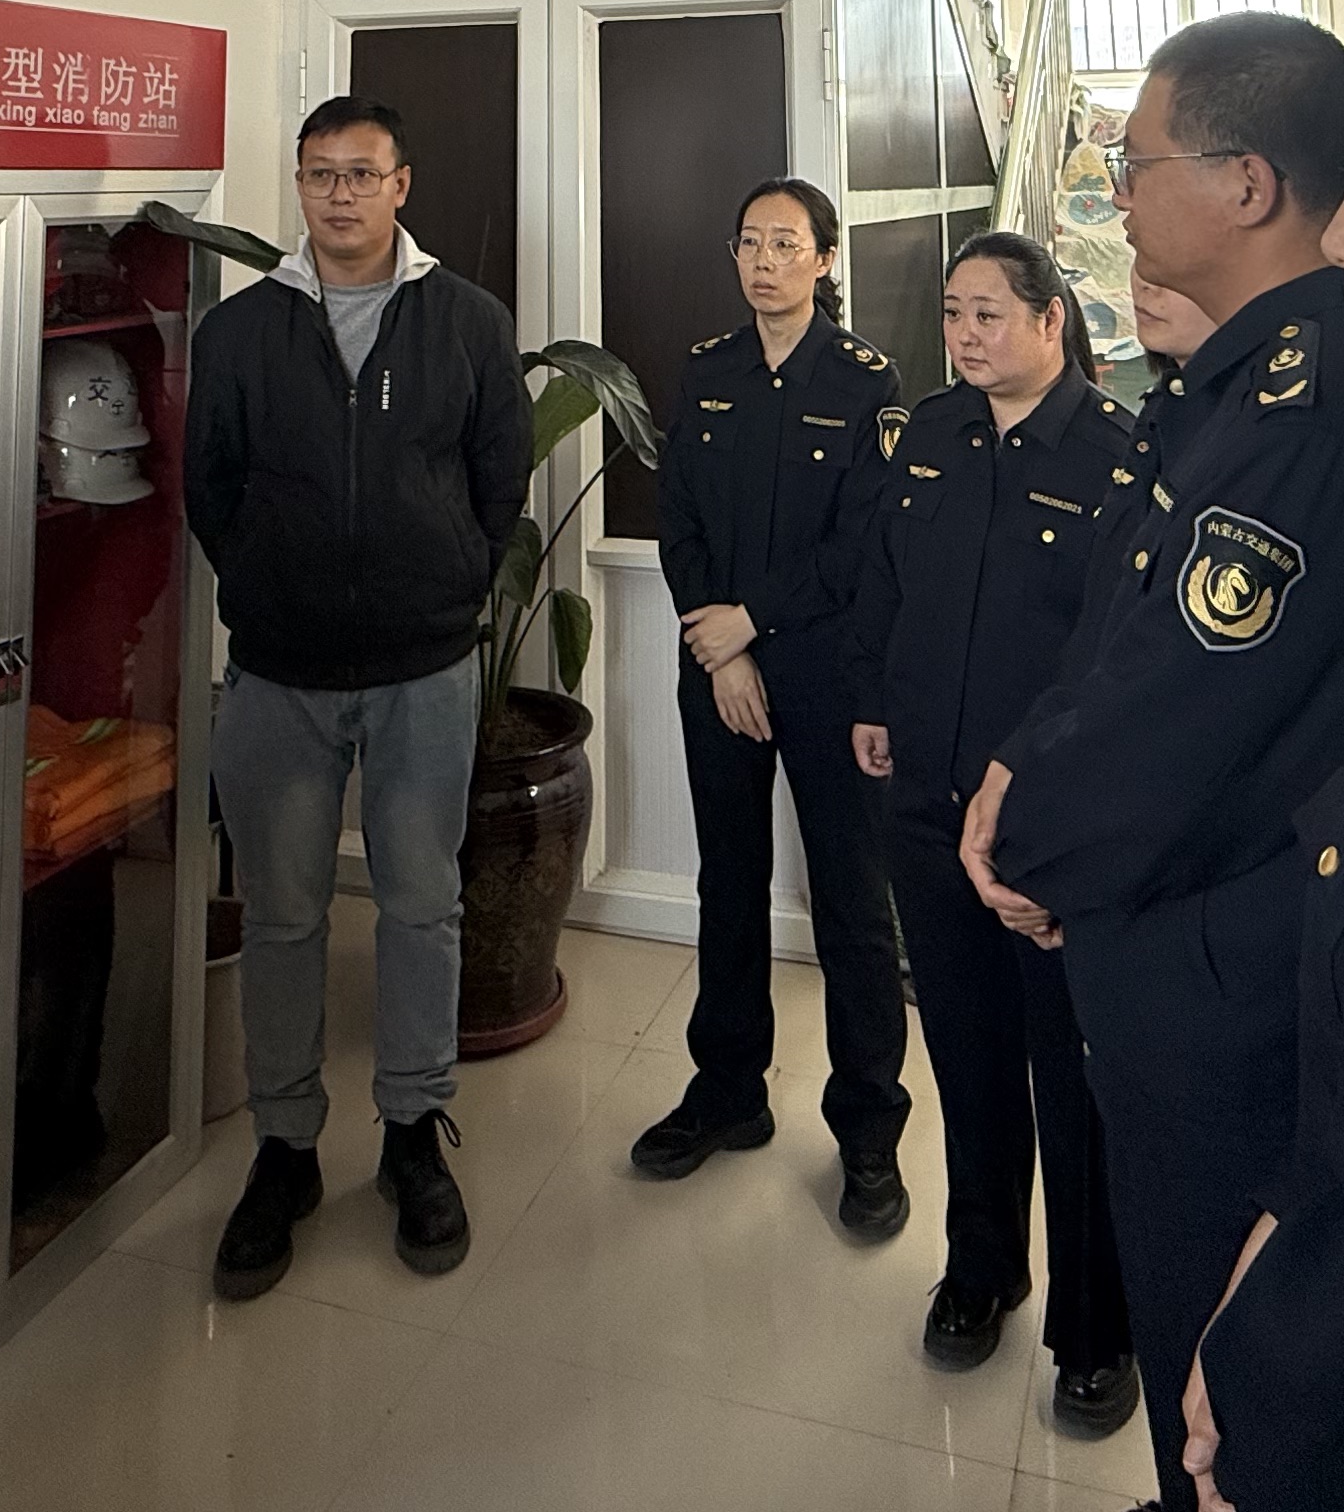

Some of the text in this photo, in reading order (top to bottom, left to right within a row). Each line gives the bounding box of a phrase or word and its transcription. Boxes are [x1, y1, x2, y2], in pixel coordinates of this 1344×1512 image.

[45, 103, 85, 125] xiao
[93, 106, 131, 132] fang
[138, 111, 178, 130] zhan
[88, 376, 112, 402] 交
[1208, 521, 1296, 573] 内蒙古交通集团
